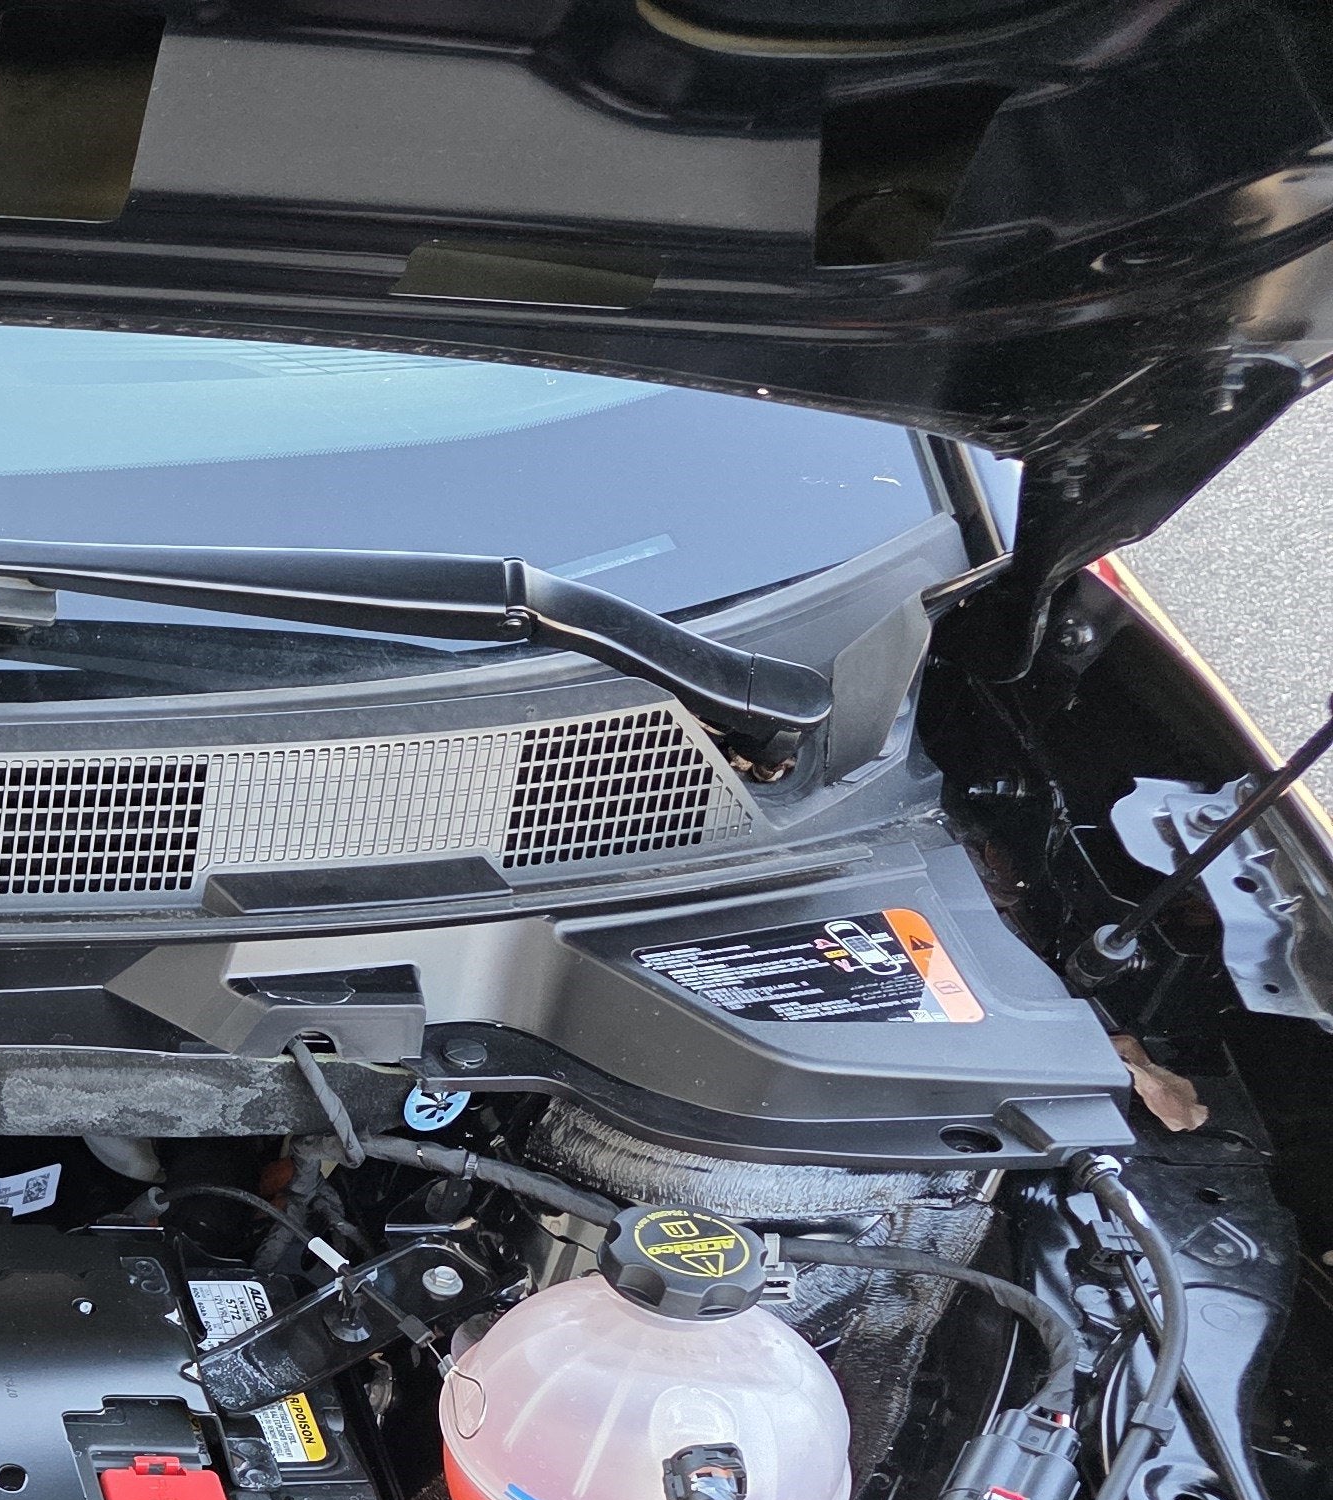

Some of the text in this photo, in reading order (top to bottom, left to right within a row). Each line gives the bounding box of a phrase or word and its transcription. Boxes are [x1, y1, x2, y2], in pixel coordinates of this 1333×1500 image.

[647, 1239, 735, 1255] ACDelco
[226, 1299, 242, 1321] 5772
[248, 1286, 268, 1321] ACDe
[290, 1397, 317, 1444] R/POISON
